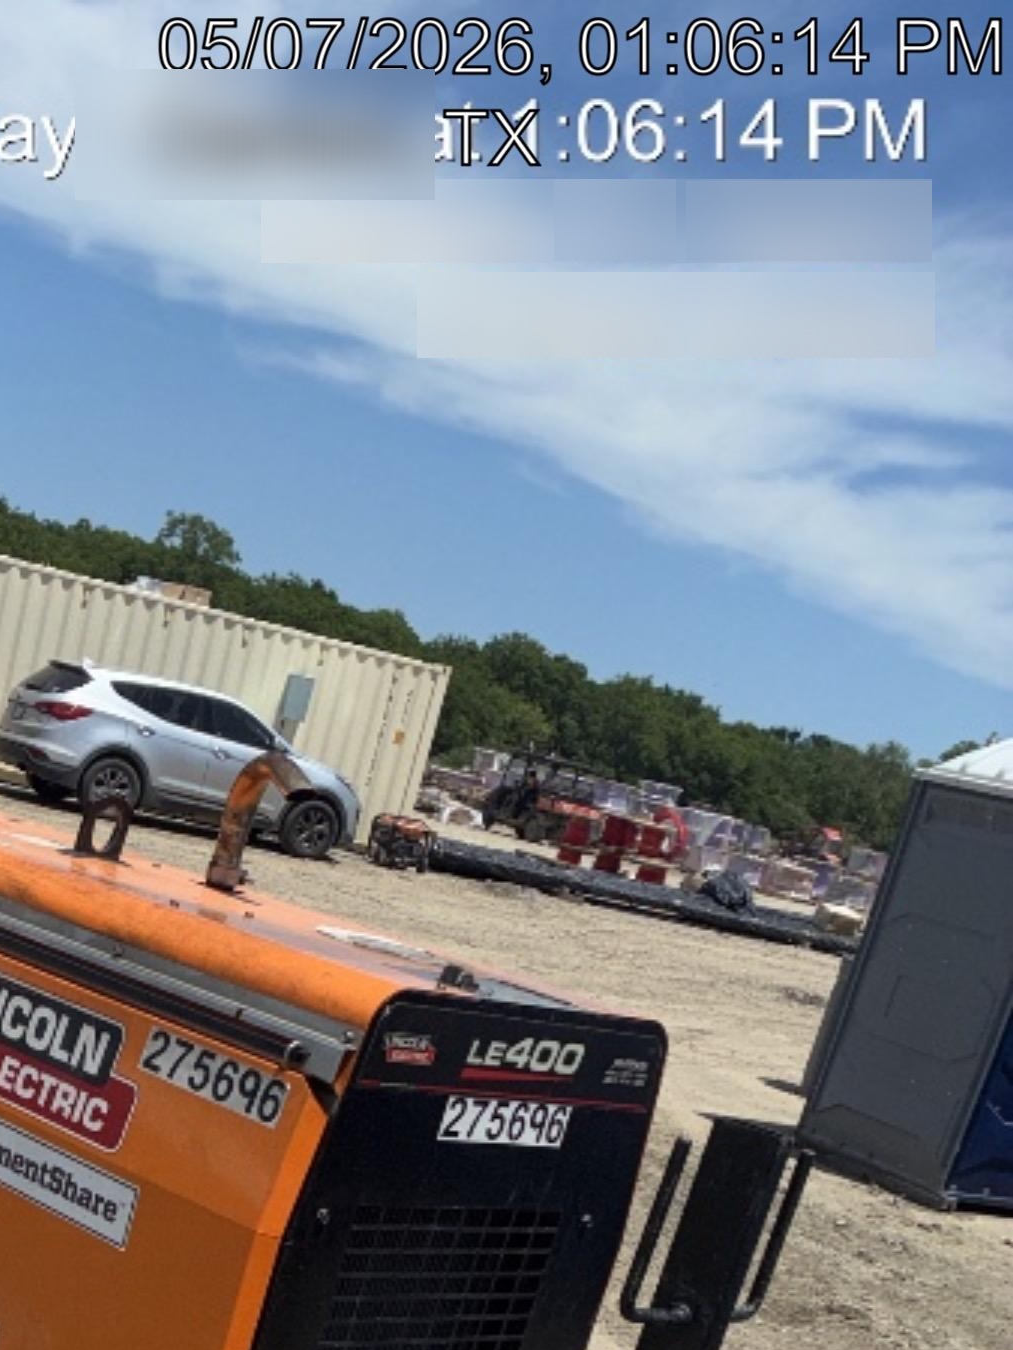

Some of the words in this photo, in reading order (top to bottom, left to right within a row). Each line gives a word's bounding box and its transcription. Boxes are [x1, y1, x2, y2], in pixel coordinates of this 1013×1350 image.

[142, 1030, 290, 1124] 275696
[466, 1037, 586, 1076] LE400
[440, 1096, 567, 1144] 275696
